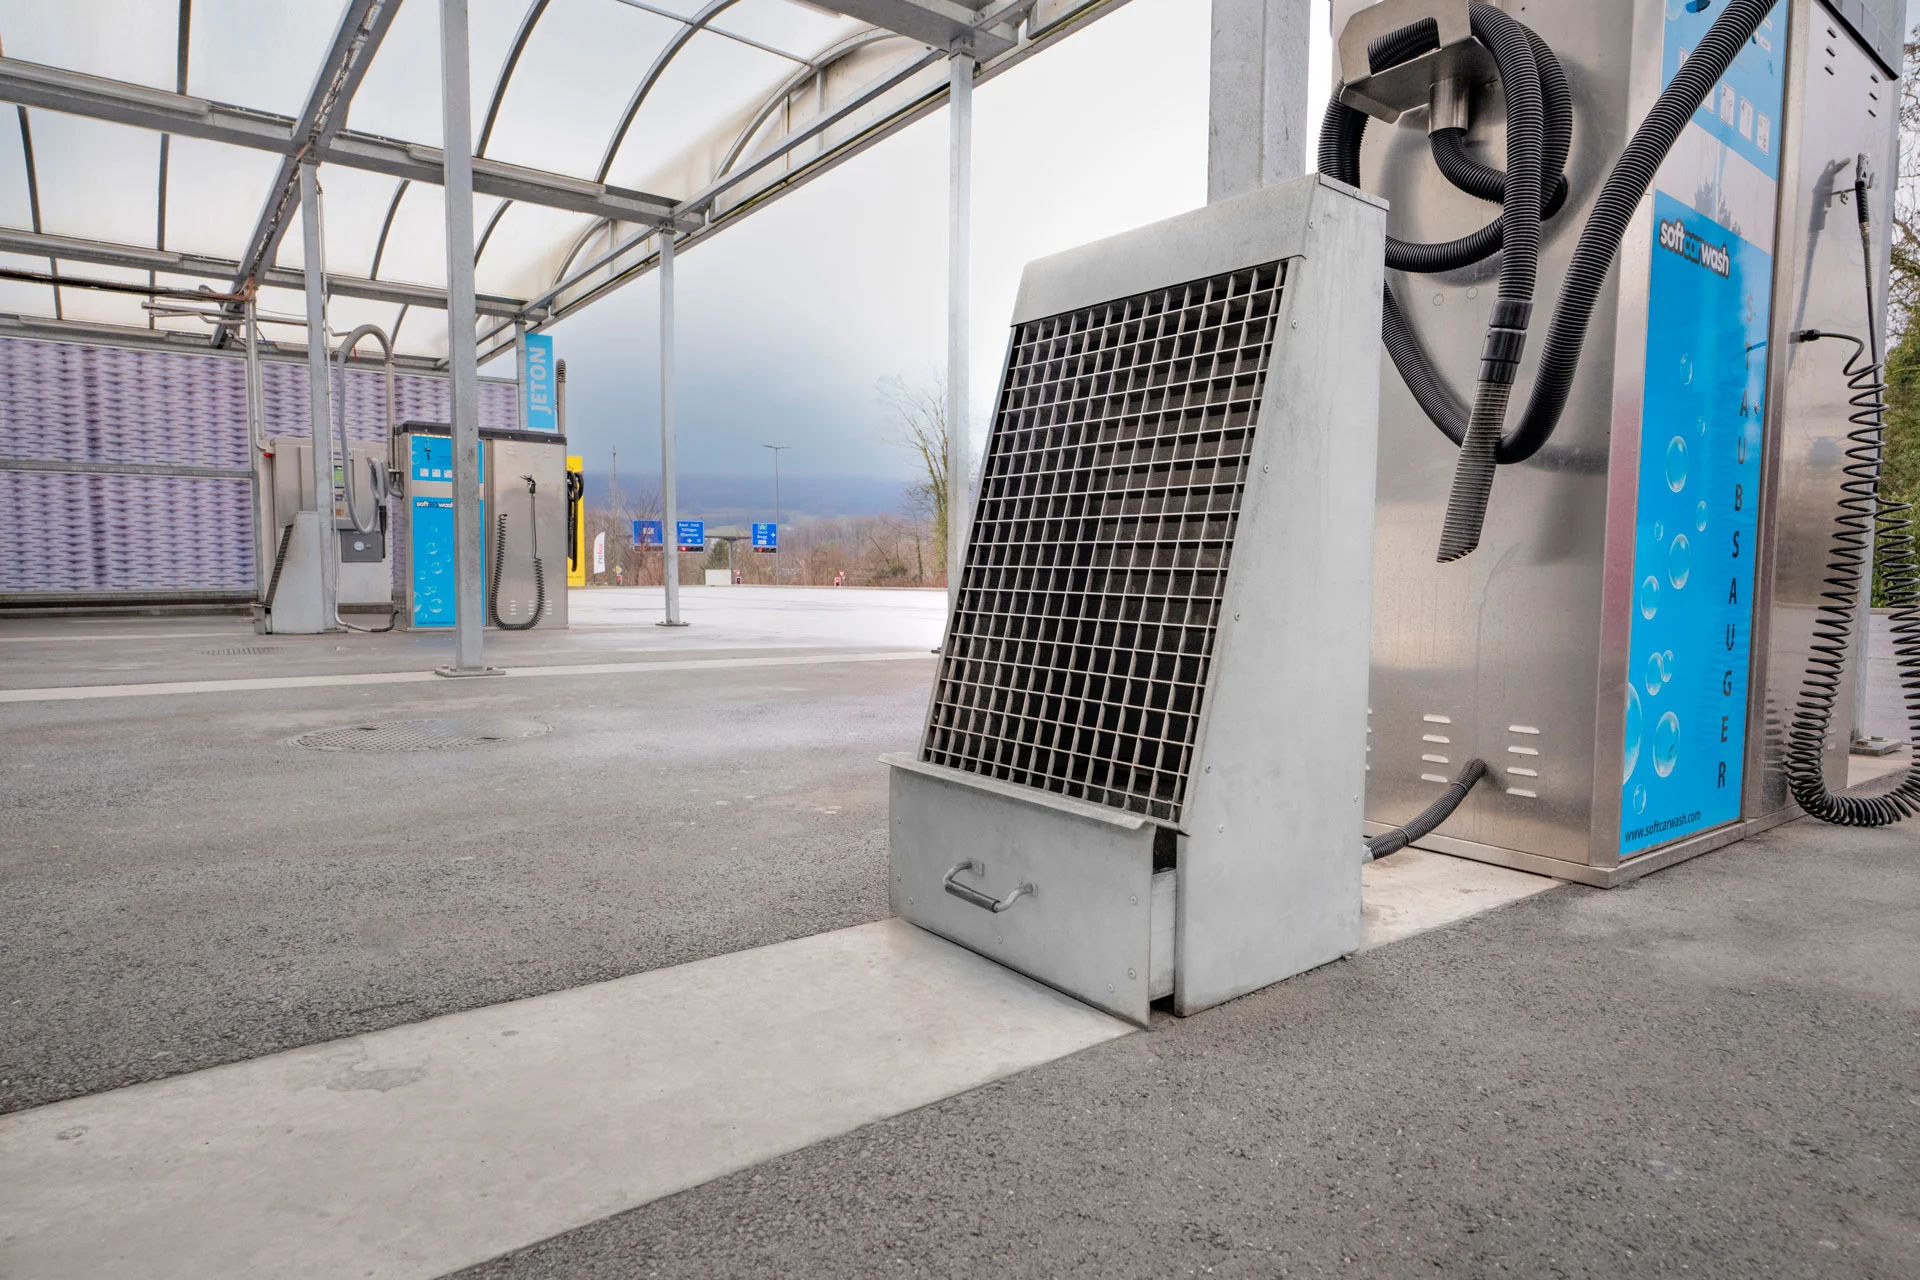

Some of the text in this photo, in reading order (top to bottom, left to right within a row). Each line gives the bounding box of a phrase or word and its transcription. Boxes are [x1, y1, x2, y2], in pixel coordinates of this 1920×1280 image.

[1660, 220, 1729, 277] softcarwash
[529, 347, 552, 415] JETON
[1625, 811, 1701, 842] www.softcarwash.com
